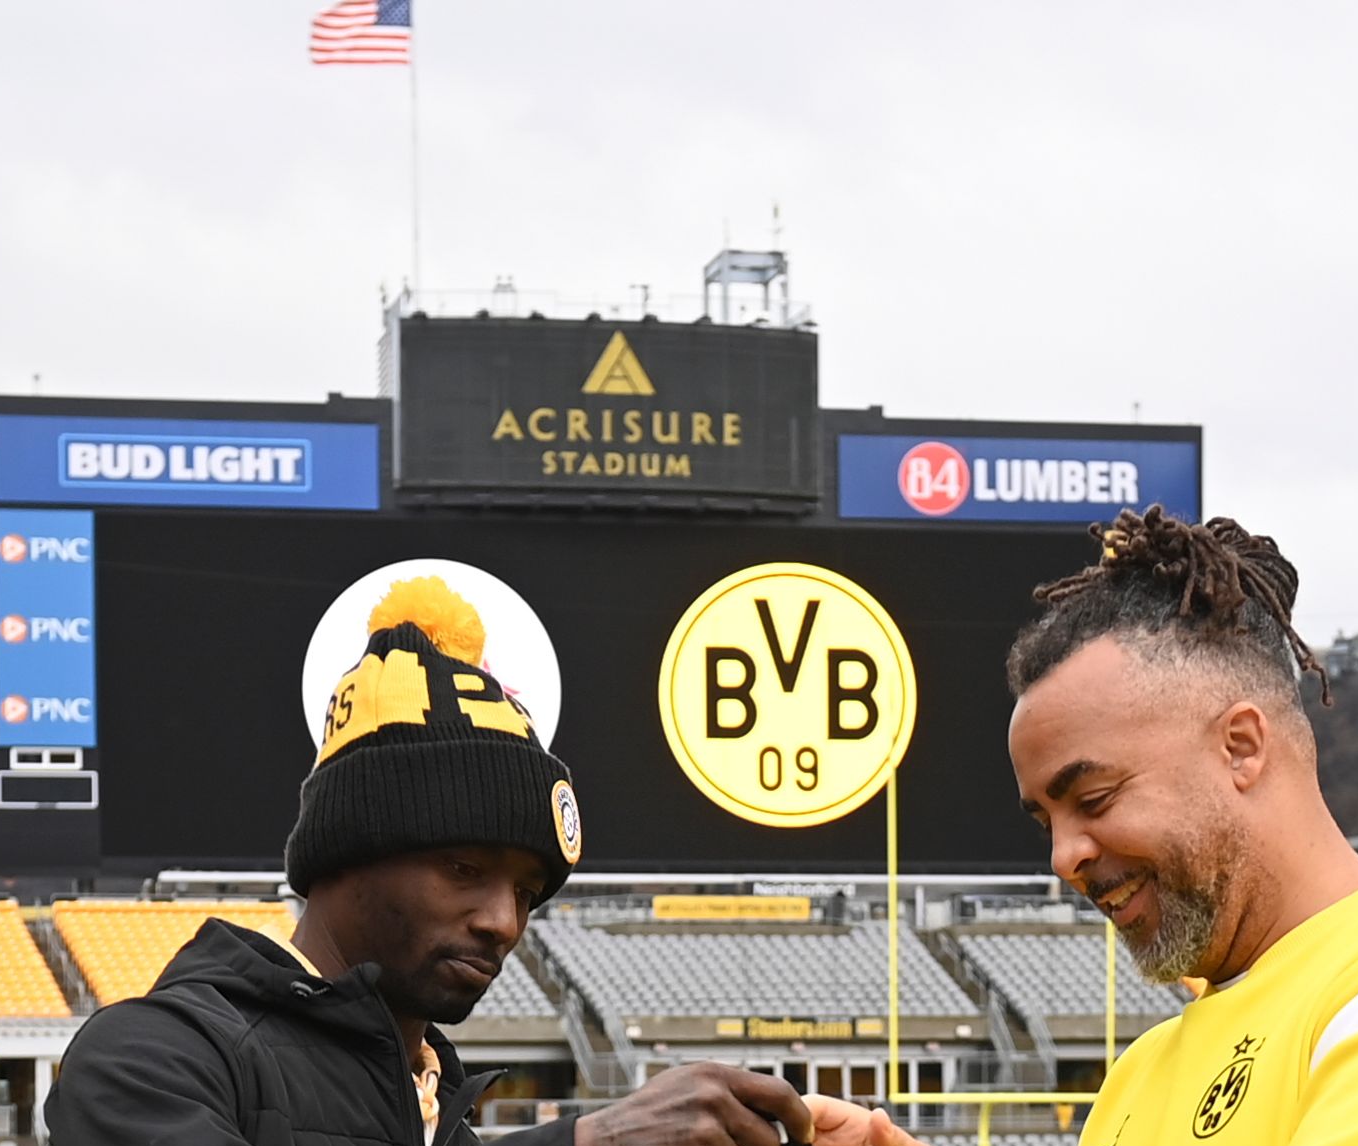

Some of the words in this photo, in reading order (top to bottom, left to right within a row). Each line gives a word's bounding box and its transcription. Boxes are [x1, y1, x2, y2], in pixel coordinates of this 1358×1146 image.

[493, 408, 741, 445] ACRISURE
[68, 442, 166, 482] BUD
[169, 446, 303, 485] LIGHT
[542, 451, 691, 477] STADIUM
[907, 457, 960, 499] 84
[974, 458, 1139, 504] LUMBER
[30, 537, 91, 562] PNC
[31, 617, 91, 643] PNC
[705, 599, 879, 740] BVB
[32, 697, 91, 723] PNC
[758, 746, 819, 792] 09
[1199, 1063, 1249, 1118] BVB
[1202, 1111, 1222, 1131] 09
